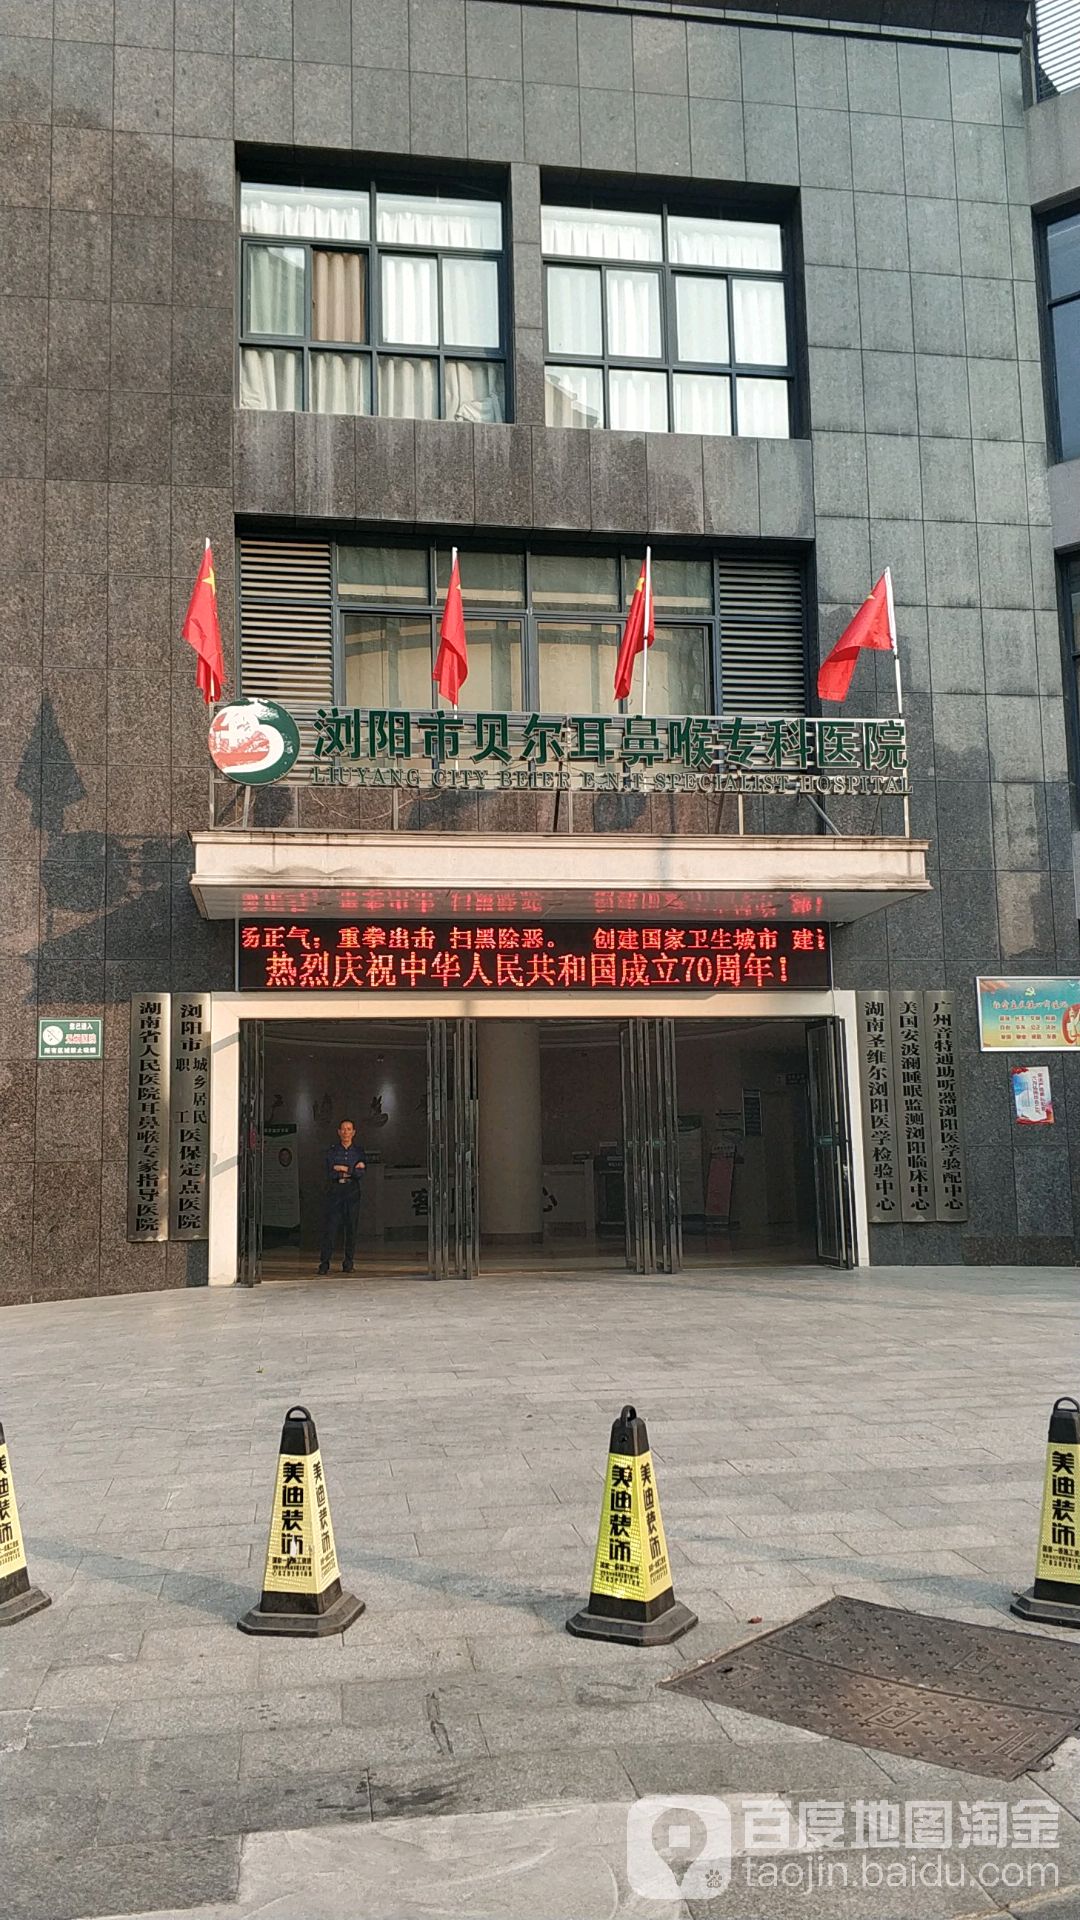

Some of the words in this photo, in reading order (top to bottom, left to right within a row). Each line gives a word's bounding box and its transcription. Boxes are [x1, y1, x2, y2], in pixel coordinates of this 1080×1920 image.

[313, 707, 908, 770] 浏阳市贝尔耳鼻喉专科医院
[313, 767, 421, 787] LIUYANG
[431, 768, 488, 789] CITY
[500, 770, 572, 790] BEIER
[653, 773, 789, 793] SPECIALIST
[800, 775, 914, 795] HOSPITAL
[135, 1001, 162, 1232] 湖南省人民医院耳鼻喉专家指导医院
[864, 1001, 896, 1211] 湖南圣维尔浏阳医学检验中心
[609, 1464, 633, 1562] 美迪装饰
[639, 1462, 662, 1559] 美迪装饰
[1051, 1451, 1076, 1547] 美迪装饰
